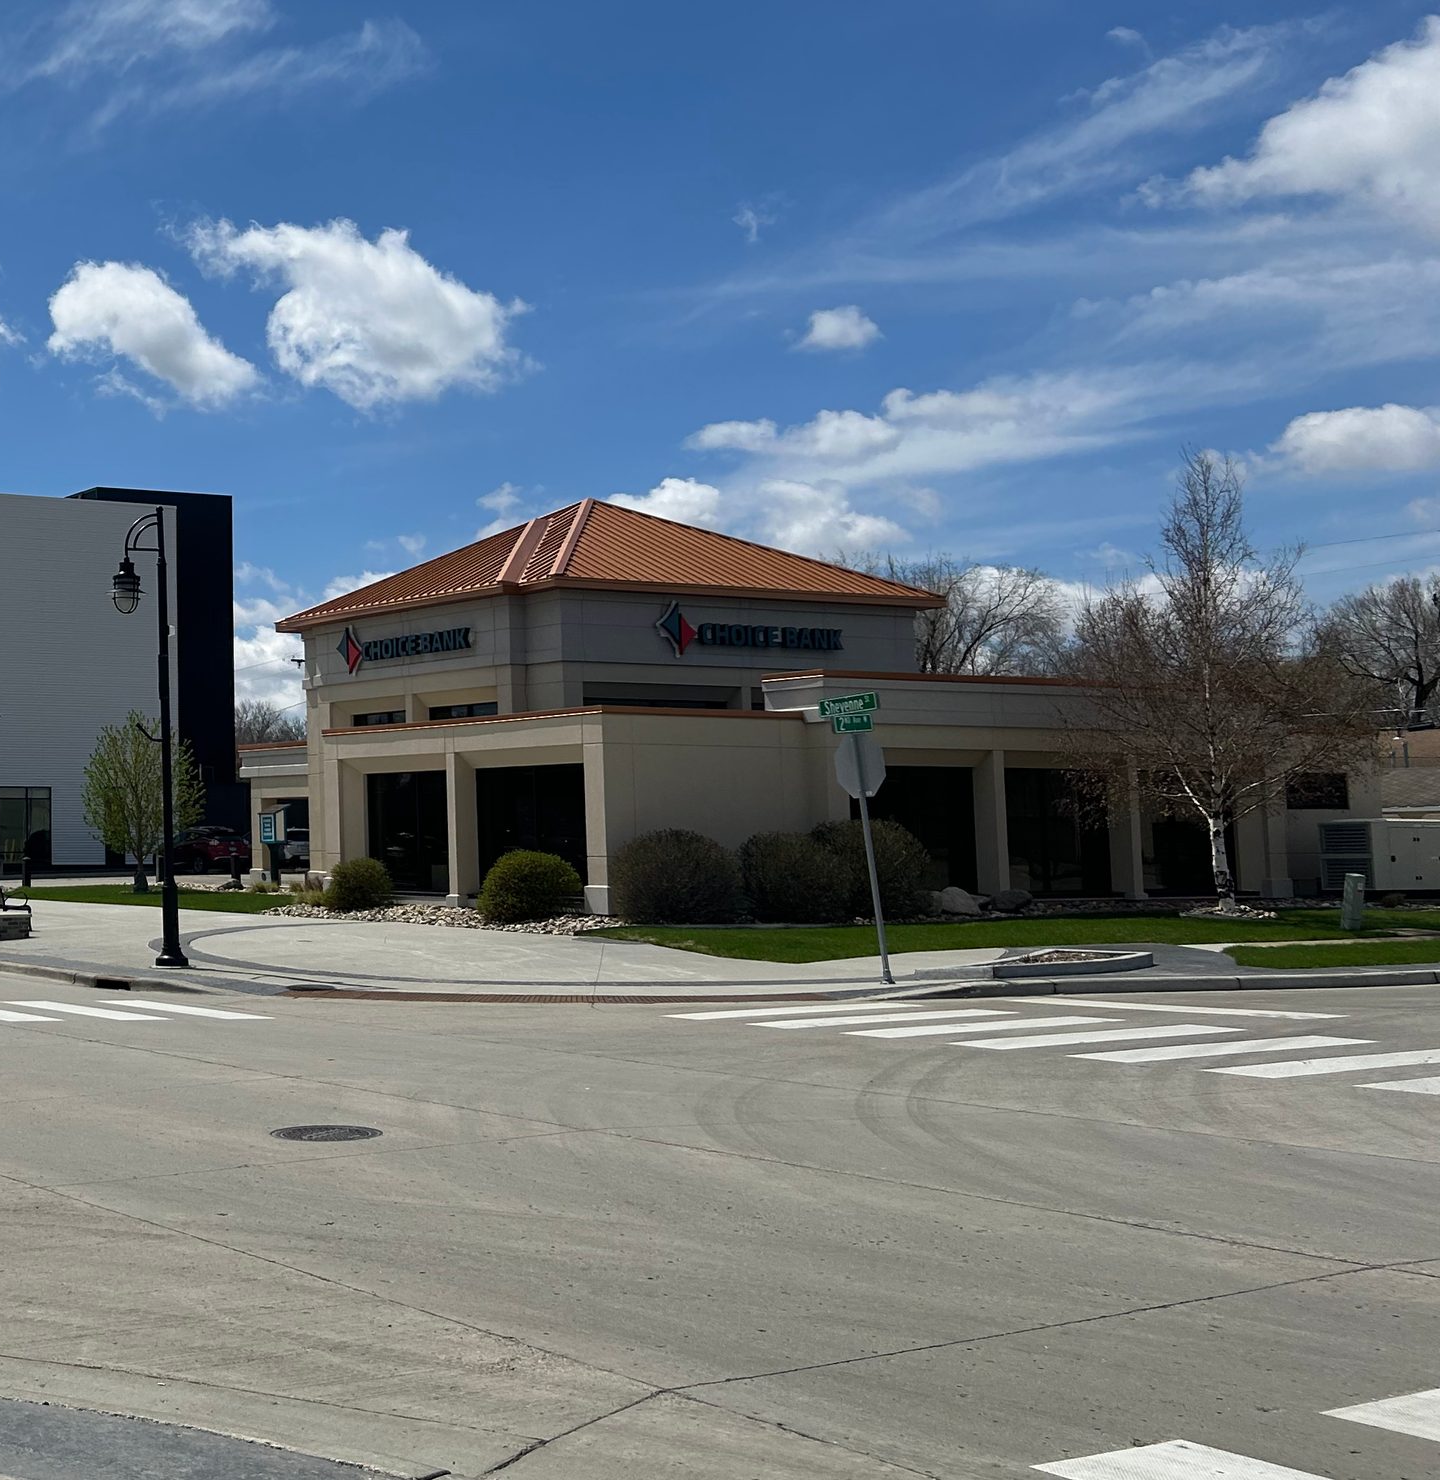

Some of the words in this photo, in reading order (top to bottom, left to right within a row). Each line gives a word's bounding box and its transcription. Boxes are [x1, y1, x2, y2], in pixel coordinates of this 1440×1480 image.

[361, 634, 419, 661] CHOICE
[419, 627, 471, 654] BANK
[698, 623, 782, 648] CHOICE
[781, 627, 844, 650] BANK
[824, 699, 863, 714] Sheyenne
